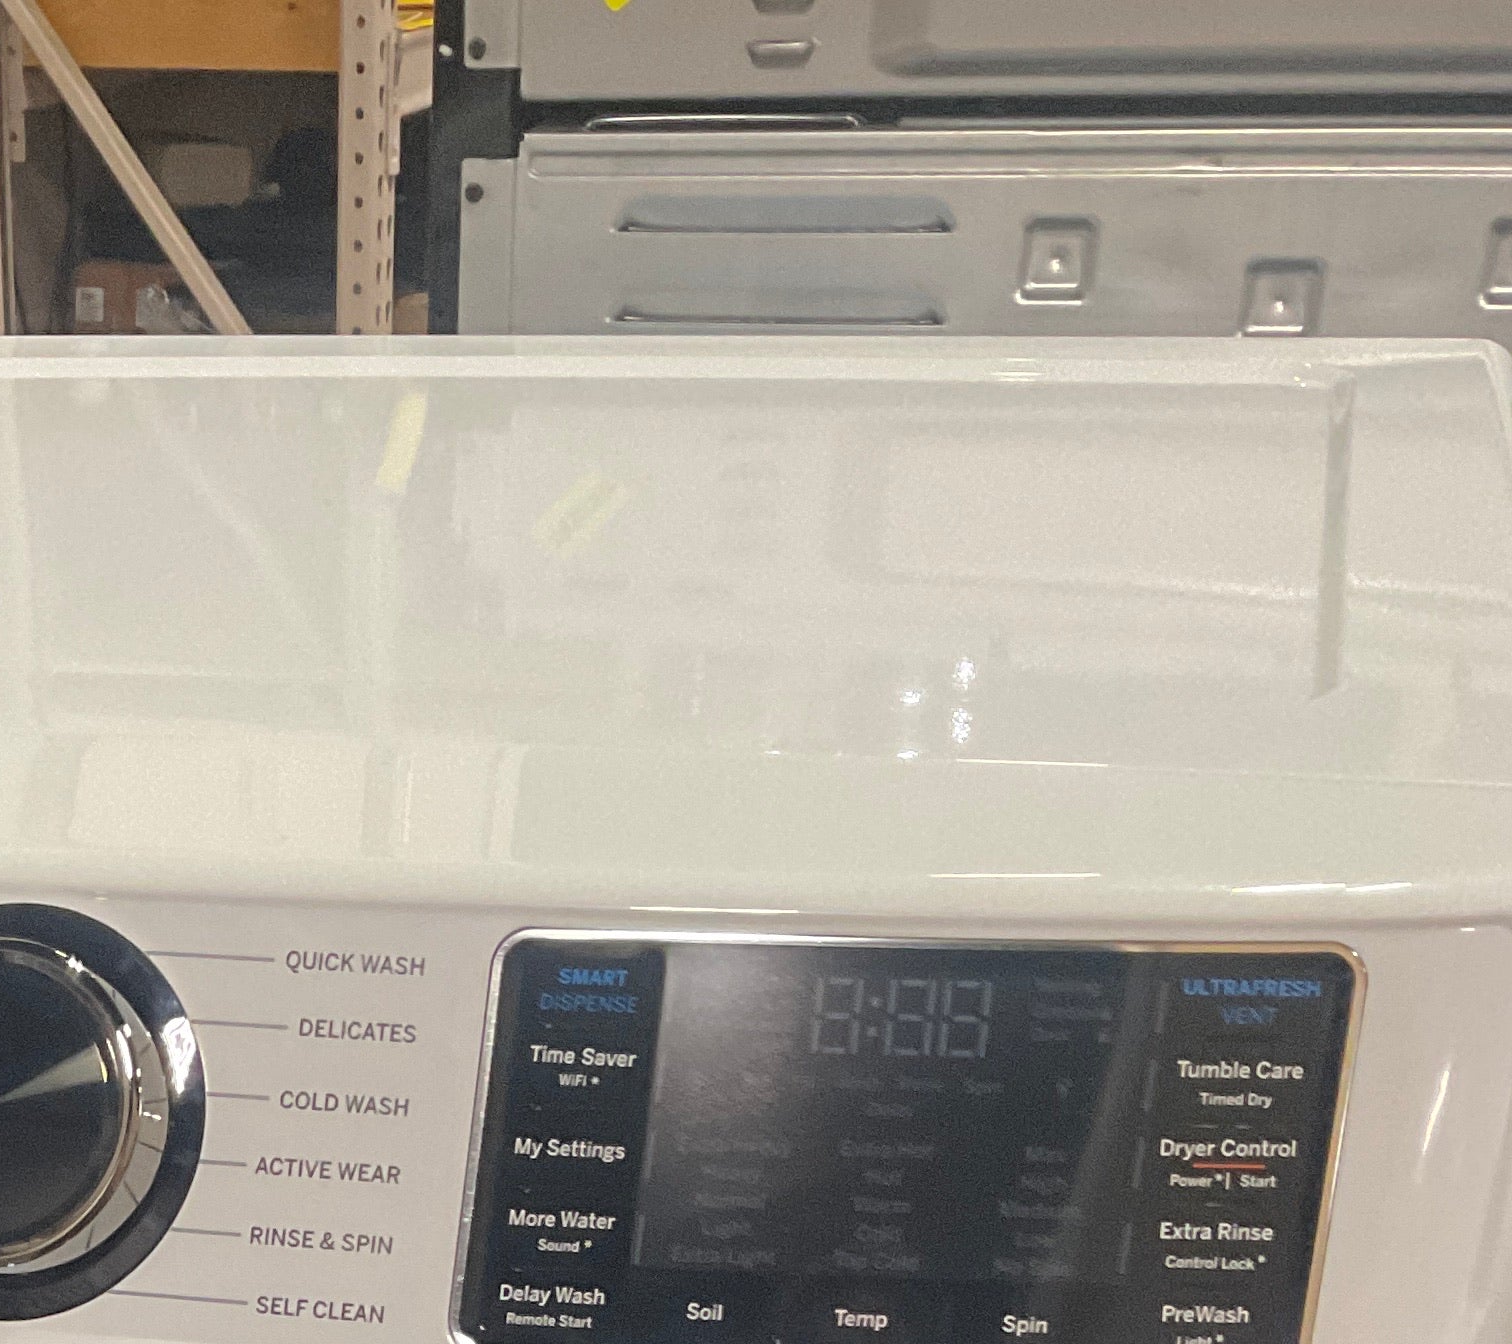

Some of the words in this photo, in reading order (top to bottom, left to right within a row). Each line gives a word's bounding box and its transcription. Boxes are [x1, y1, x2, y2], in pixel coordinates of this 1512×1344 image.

[286, 950, 355, 974] QUICK
[361, 954, 426, 976] WASH
[558, 967, 629, 987] SMART
[1182, 977, 1322, 998] ULTRAFRESH
[539, 993, 639, 1014] DISPENSE
[1220, 1004, 1279, 1025] VENT
[299, 1017, 417, 1044] DELICATES
[530, 1044, 575, 1065] Time
[581, 1047, 638, 1068] Saver
[1177, 1060, 1251, 1079] Tumble
[1256, 1061, 1305, 1080] Care
[279, 1090, 339, 1112] COLD
[345, 1094, 410, 1117] WASH
[1199, 1091, 1245, 1107] Timed
[1247, 1092, 1273, 1109] Dry
[514, 1137, 543, 1160] My
[546, 1139, 626, 1163] Settings
[1159, 1139, 1216, 1161] Dryer
[1220, 1139, 1297, 1158] Control
[255, 1157, 333, 1180] ACTIVE
[338, 1162, 401, 1185] WEAR
[1169, 1173, 1212, 1188] Power
[1239, 1174, 1278, 1188] Start
[508, 1208, 556, 1227] More
[560, 1210, 617, 1230] Water
[249, 1226, 315, 1249] RINSE
[319, 1232, 335, 1250] &
[341, 1233, 393, 1255] SPIN
[1159, 1221, 1212, 1241] Extra
[1217, 1222, 1275, 1242] Rinse
[537, 1238, 580, 1253] Sound
[1165, 1255, 1218, 1269] Control
[1221, 1256, 1255, 1271] Lock
[499, 1283, 551, 1307] Delay
[555, 1286, 606, 1305] Wash
[255, 1295, 309, 1317] SELF
[312, 1300, 385, 1324] CLEAN
[686, 1301, 724, 1322] Soil
[834, 1308, 888, 1331] Temp
[1161, 1305, 1250, 1324] PreWash
[505, 1312, 556, 1327] Remote
[558, 1314, 593, 1329] Start
[1001, 1315, 1049, 1337] Spin
